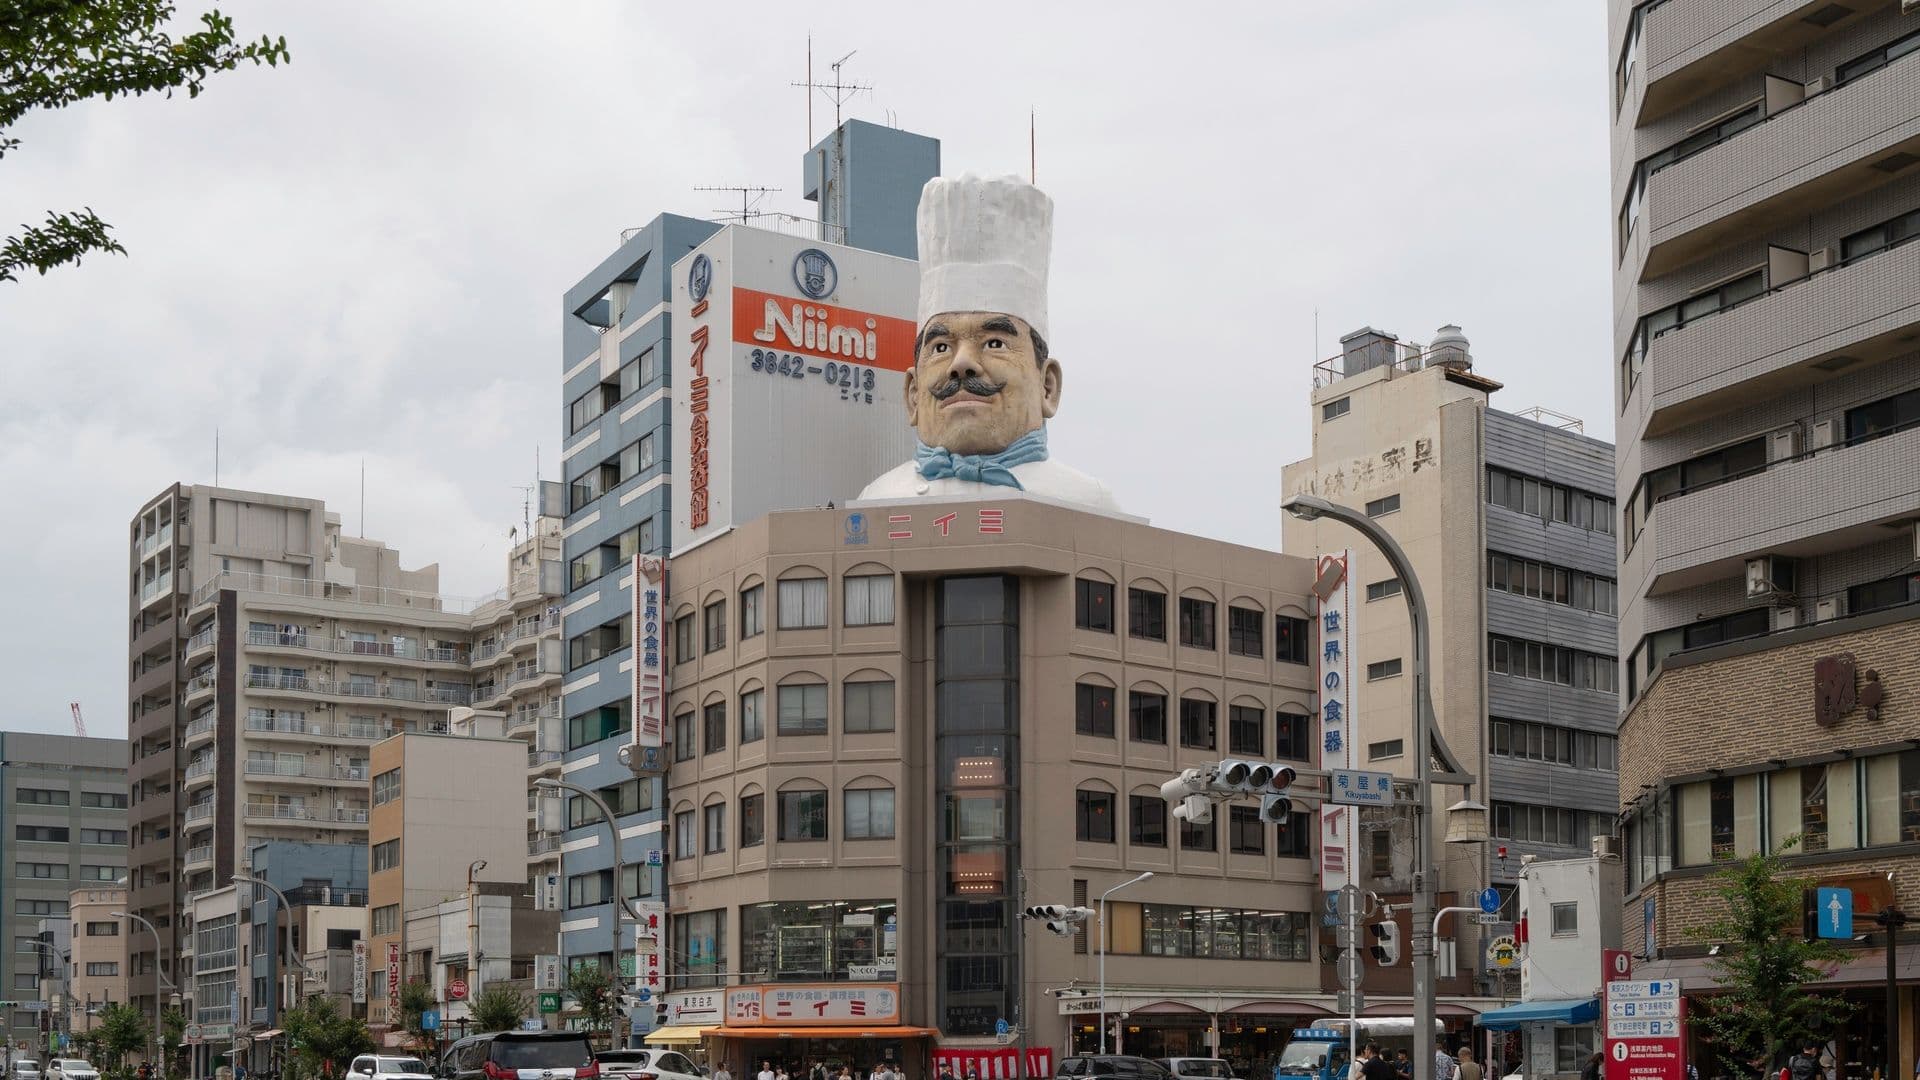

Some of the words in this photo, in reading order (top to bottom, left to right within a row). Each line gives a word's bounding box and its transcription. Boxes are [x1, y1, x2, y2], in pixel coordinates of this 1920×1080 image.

[753, 299, 876, 360] Niimi
[751, 349, 876, 391] 3842-0213
[889, 510, 1003, 539] ニイミ
[644, 589, 659, 667] 世界の食器
[1323, 610, 1342, 752] 世界の食器
[642, 674, 660, 735] ニイミ
[1338, 775, 1389, 791] 菊屋橋
[1345, 791, 1382, 800] Kikuyabashi
[879, 958, 895, 966] N4
[777, 1001, 866, 1016] ニイミ
